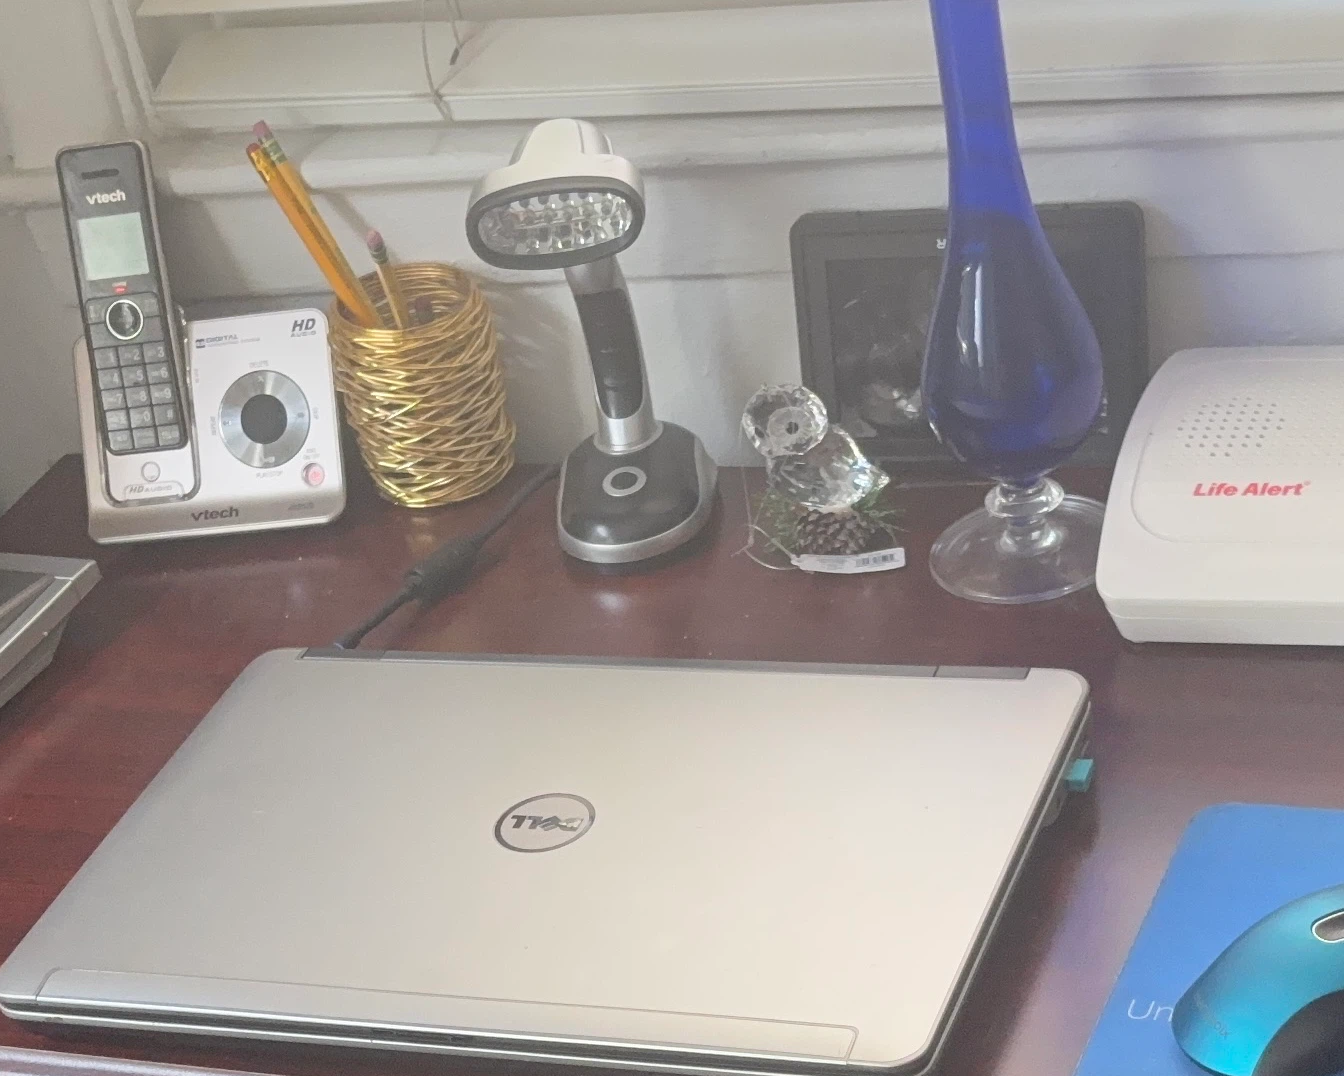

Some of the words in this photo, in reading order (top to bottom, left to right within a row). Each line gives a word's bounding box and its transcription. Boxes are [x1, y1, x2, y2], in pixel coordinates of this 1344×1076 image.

[86, 188, 126, 205] vtech
[292, 318, 316, 332] HD
[206, 334, 238, 343] DIGITAL
[134, 350, 141, 361] 2
[158, 347, 165, 358] 3
[161, 367, 168, 378] 6
[140, 391, 147, 402] 8
[165, 388, 172, 399] 9
[130, 486, 144, 494] HD
[1193, 482, 1238, 497] Life
[191, 506, 239, 522] vtech
[511, 815, 584, 832] DELL
